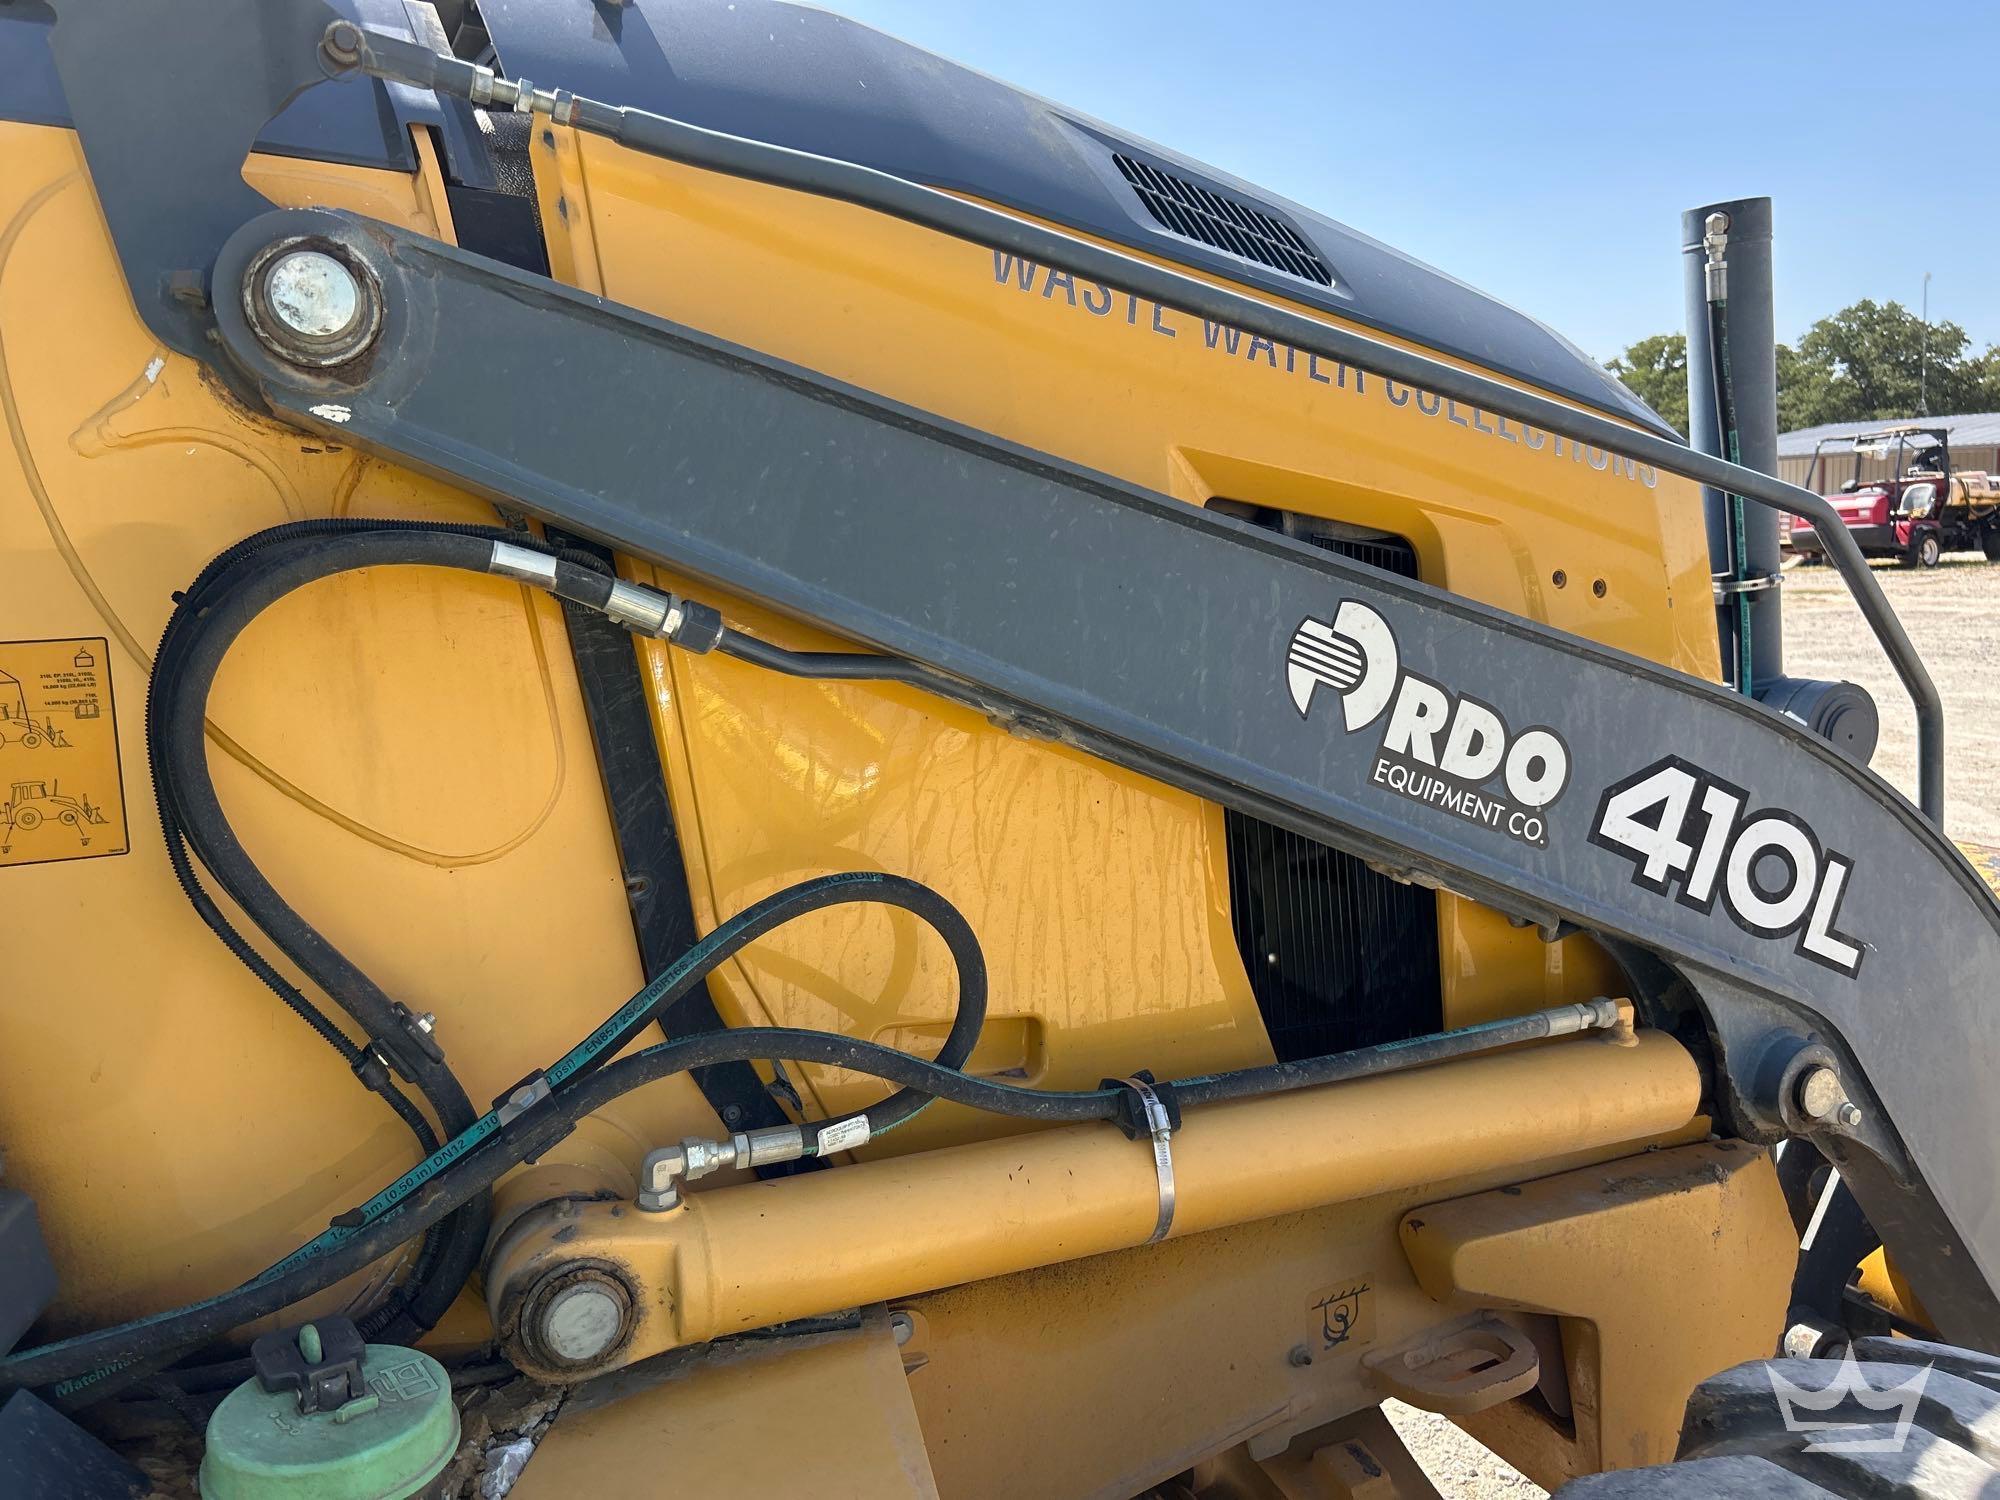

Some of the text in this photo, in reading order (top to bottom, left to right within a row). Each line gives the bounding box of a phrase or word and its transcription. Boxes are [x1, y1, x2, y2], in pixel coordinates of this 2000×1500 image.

[1374, 758, 1546, 845] EQUIPMENT CO.
[1598, 765, 1860, 970] 410L
[383, 1176, 416, 1203] (0.50
[413, 1163, 433, 1182] in)
[431, 1138, 468, 1167] DN12
[583, 1021, 620, 1054] EN857
